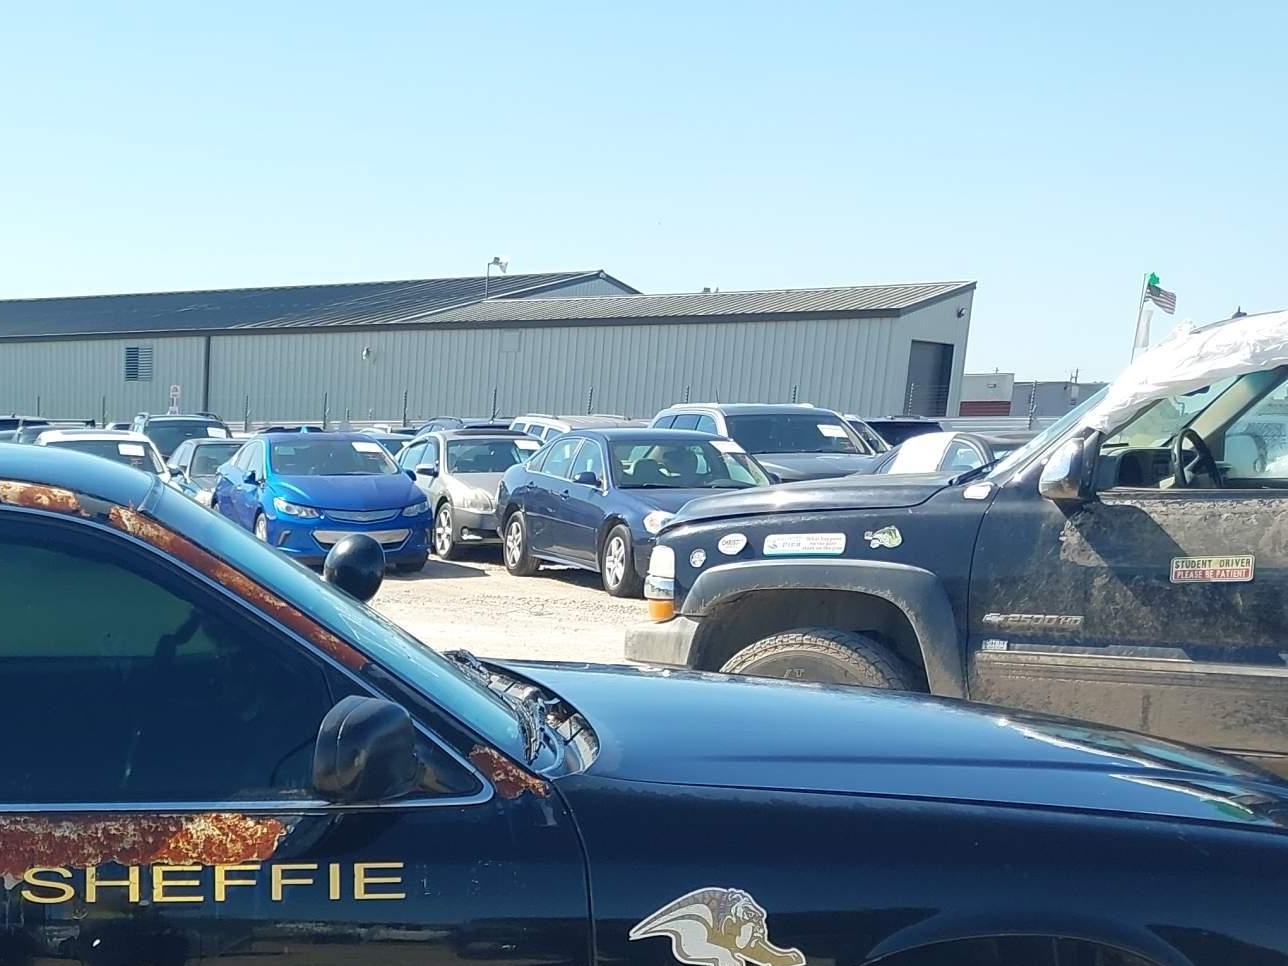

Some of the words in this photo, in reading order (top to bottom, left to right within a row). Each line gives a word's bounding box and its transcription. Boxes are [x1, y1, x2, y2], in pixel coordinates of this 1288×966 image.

[1175, 560, 1212, 569] STUDENT
[1219, 559, 1251, 568] DRIVER
[1176, 570, 1203, 579] PLEASE
[1205, 570, 1214, 578] BE
[1215, 569, 1248, 578] PATIENT
[20, 862, 406, 904] SHEFFIE
